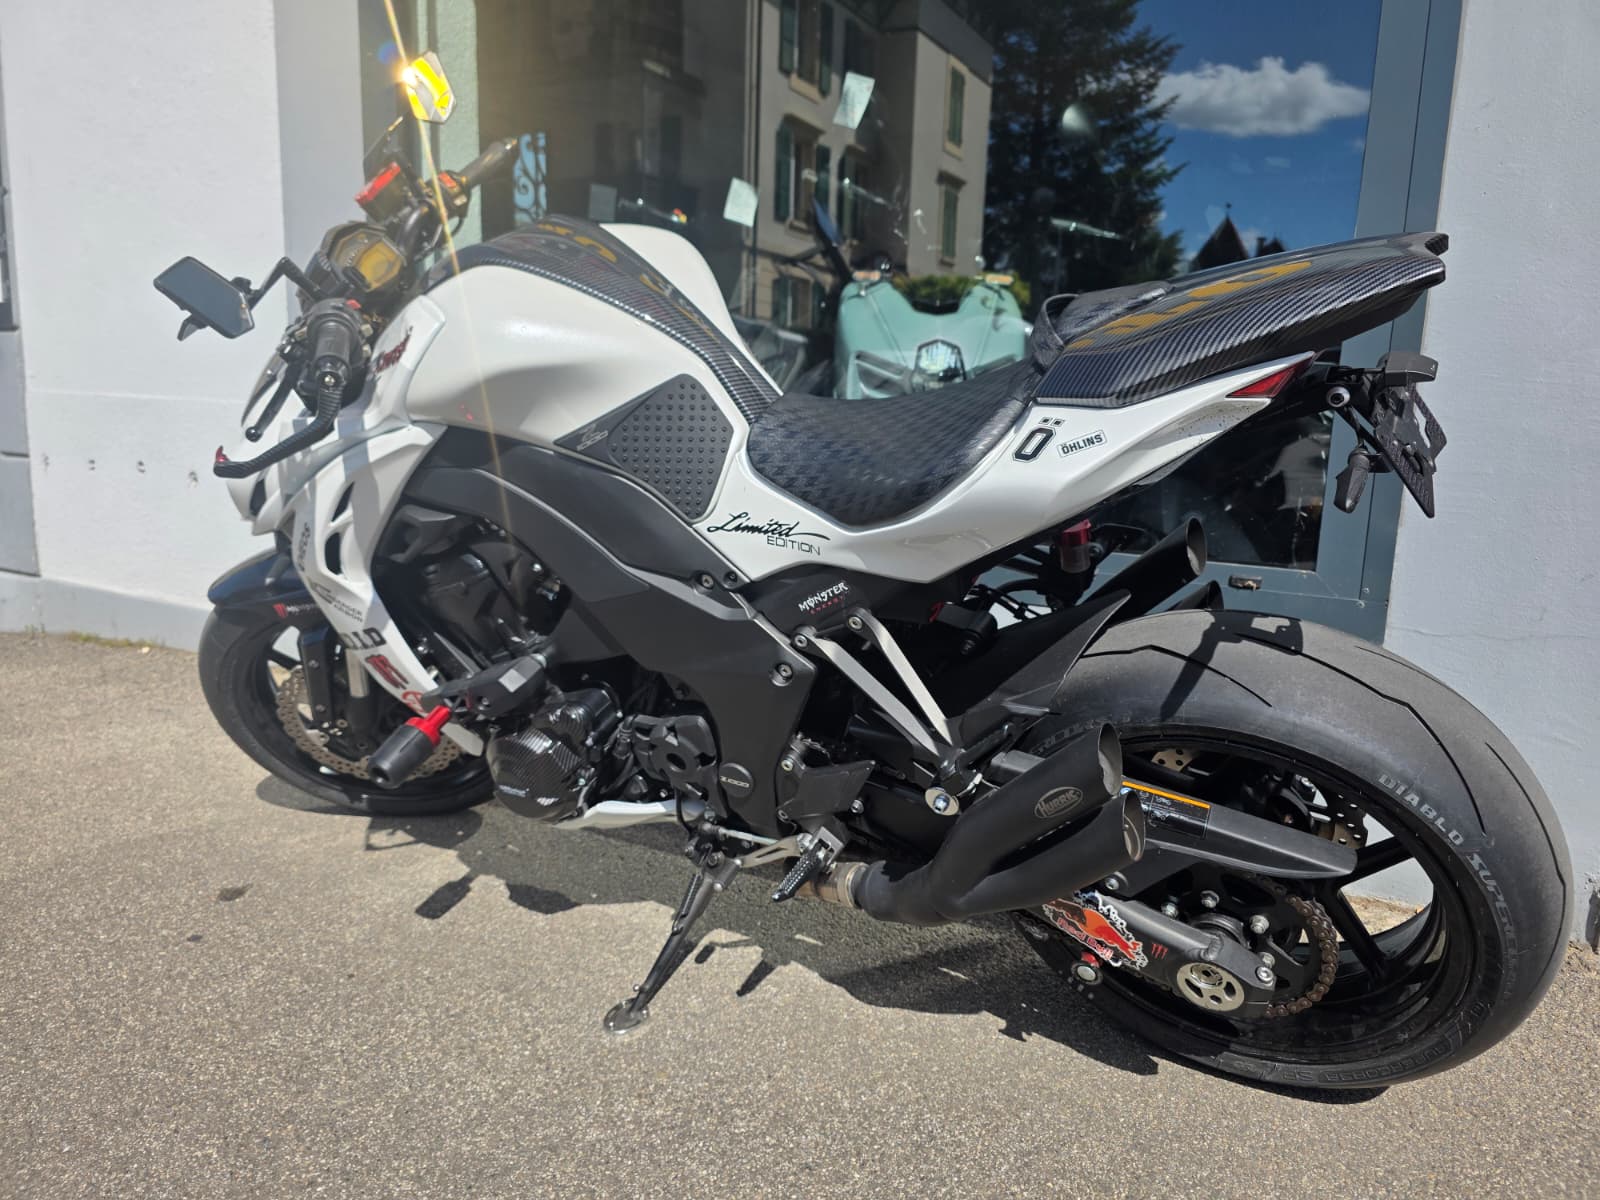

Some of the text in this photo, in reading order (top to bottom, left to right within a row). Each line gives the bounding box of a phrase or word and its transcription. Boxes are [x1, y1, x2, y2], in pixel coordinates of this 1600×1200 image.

[1060, 433, 1104, 455] ÖHLINS
[706, 511, 832, 541] Limited
[766, 535, 821, 556] EDITION
[798, 582, 849, 612] MONSTER
[1378, 773, 1465, 847] DIABLO
